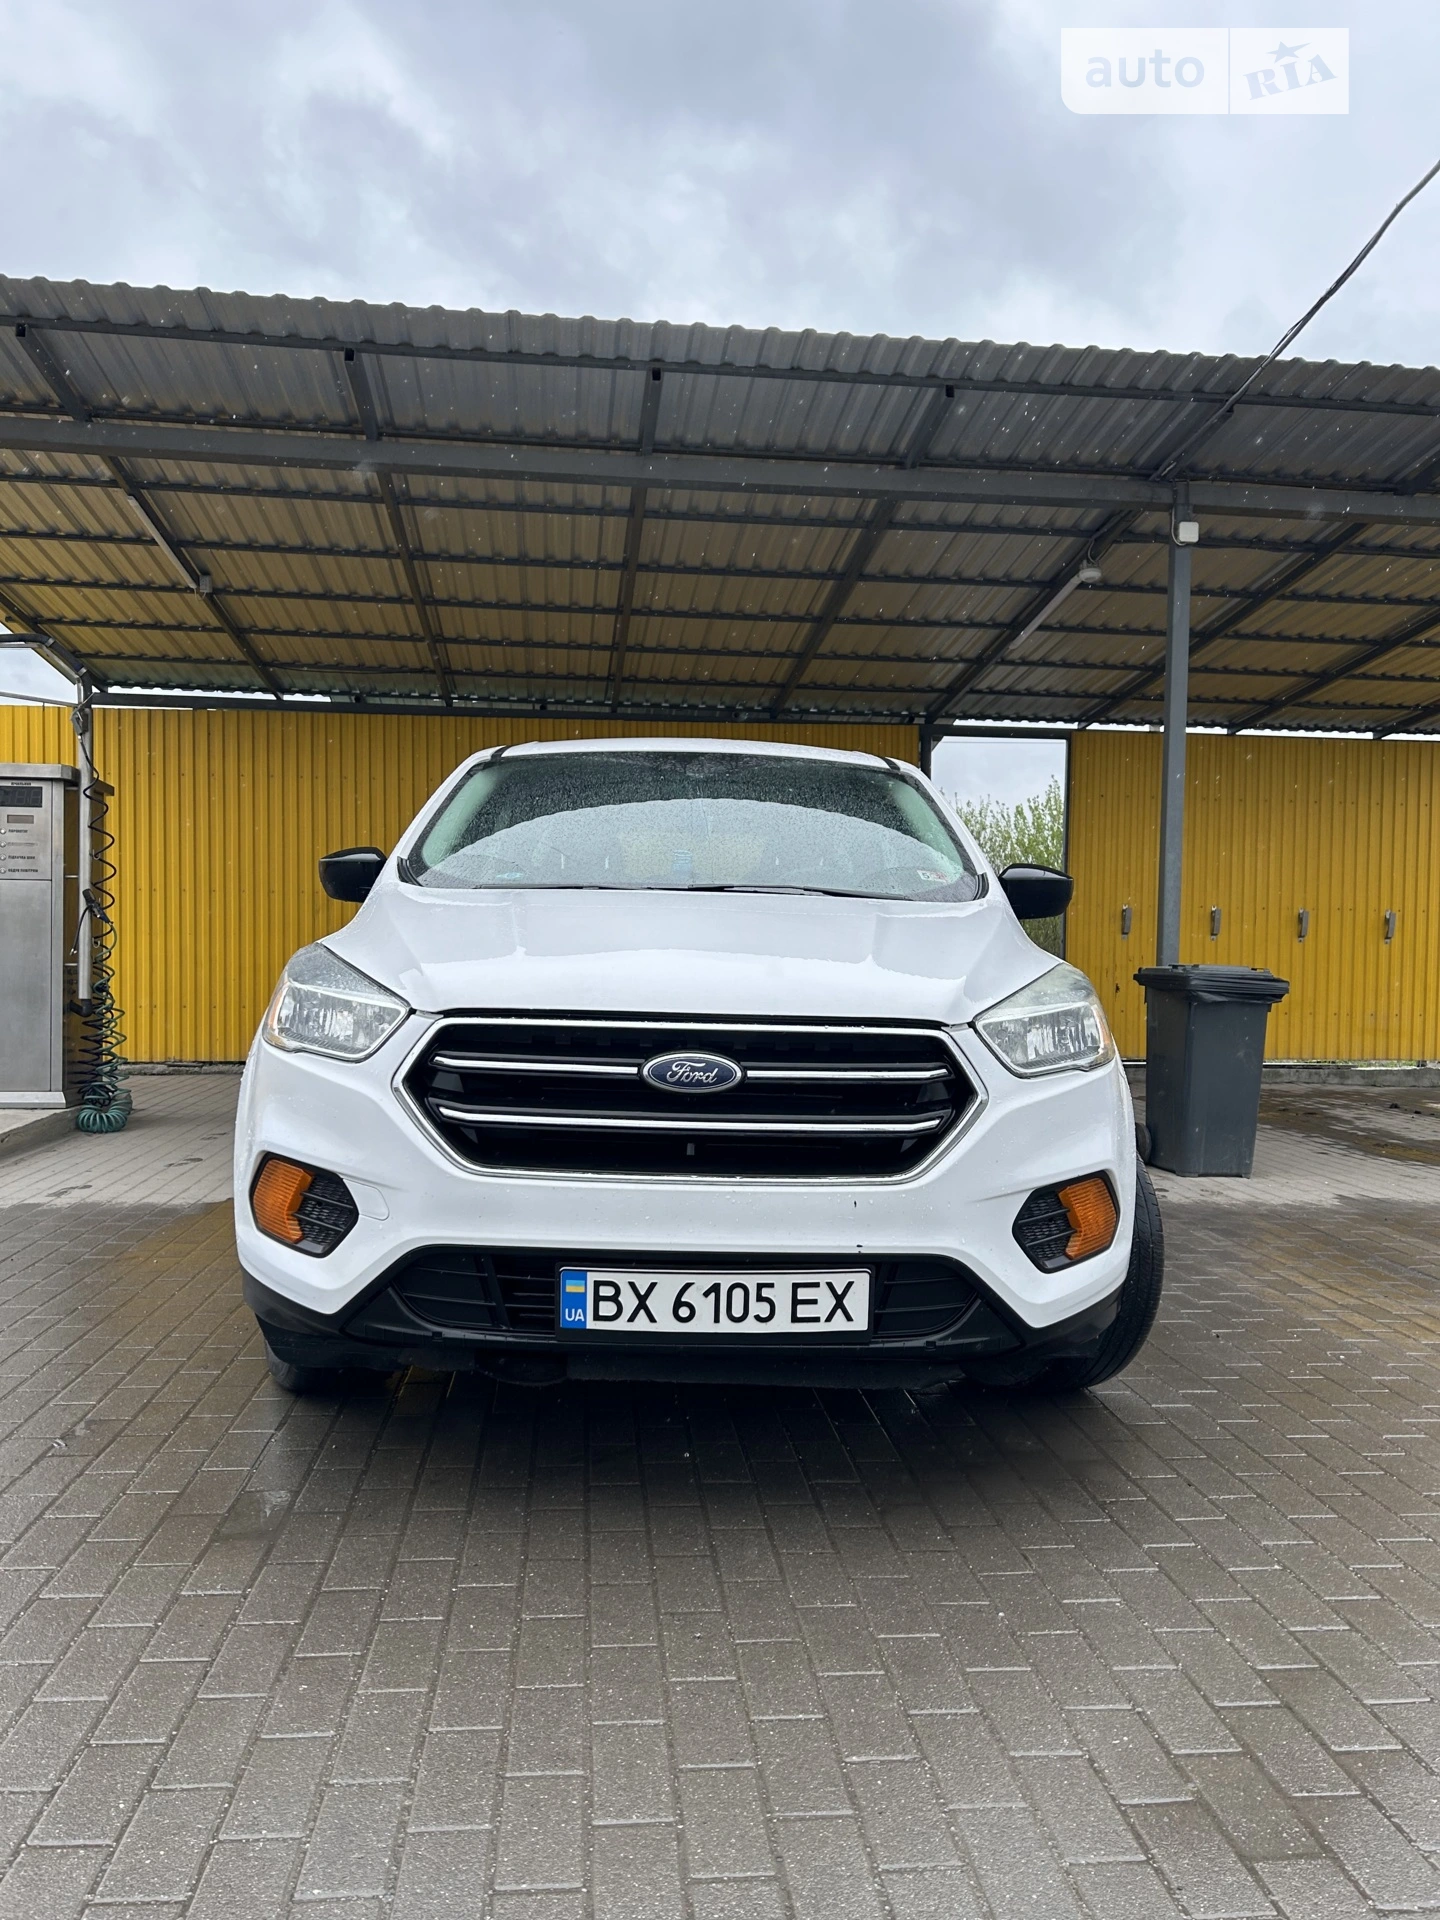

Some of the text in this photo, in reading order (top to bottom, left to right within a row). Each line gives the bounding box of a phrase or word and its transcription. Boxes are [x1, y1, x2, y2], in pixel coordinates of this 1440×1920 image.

[666, 1061, 718, 1083] Ford
[592, 1280, 855, 1323] BX 6105 EX
[565, 1308, 585, 1322] UA
